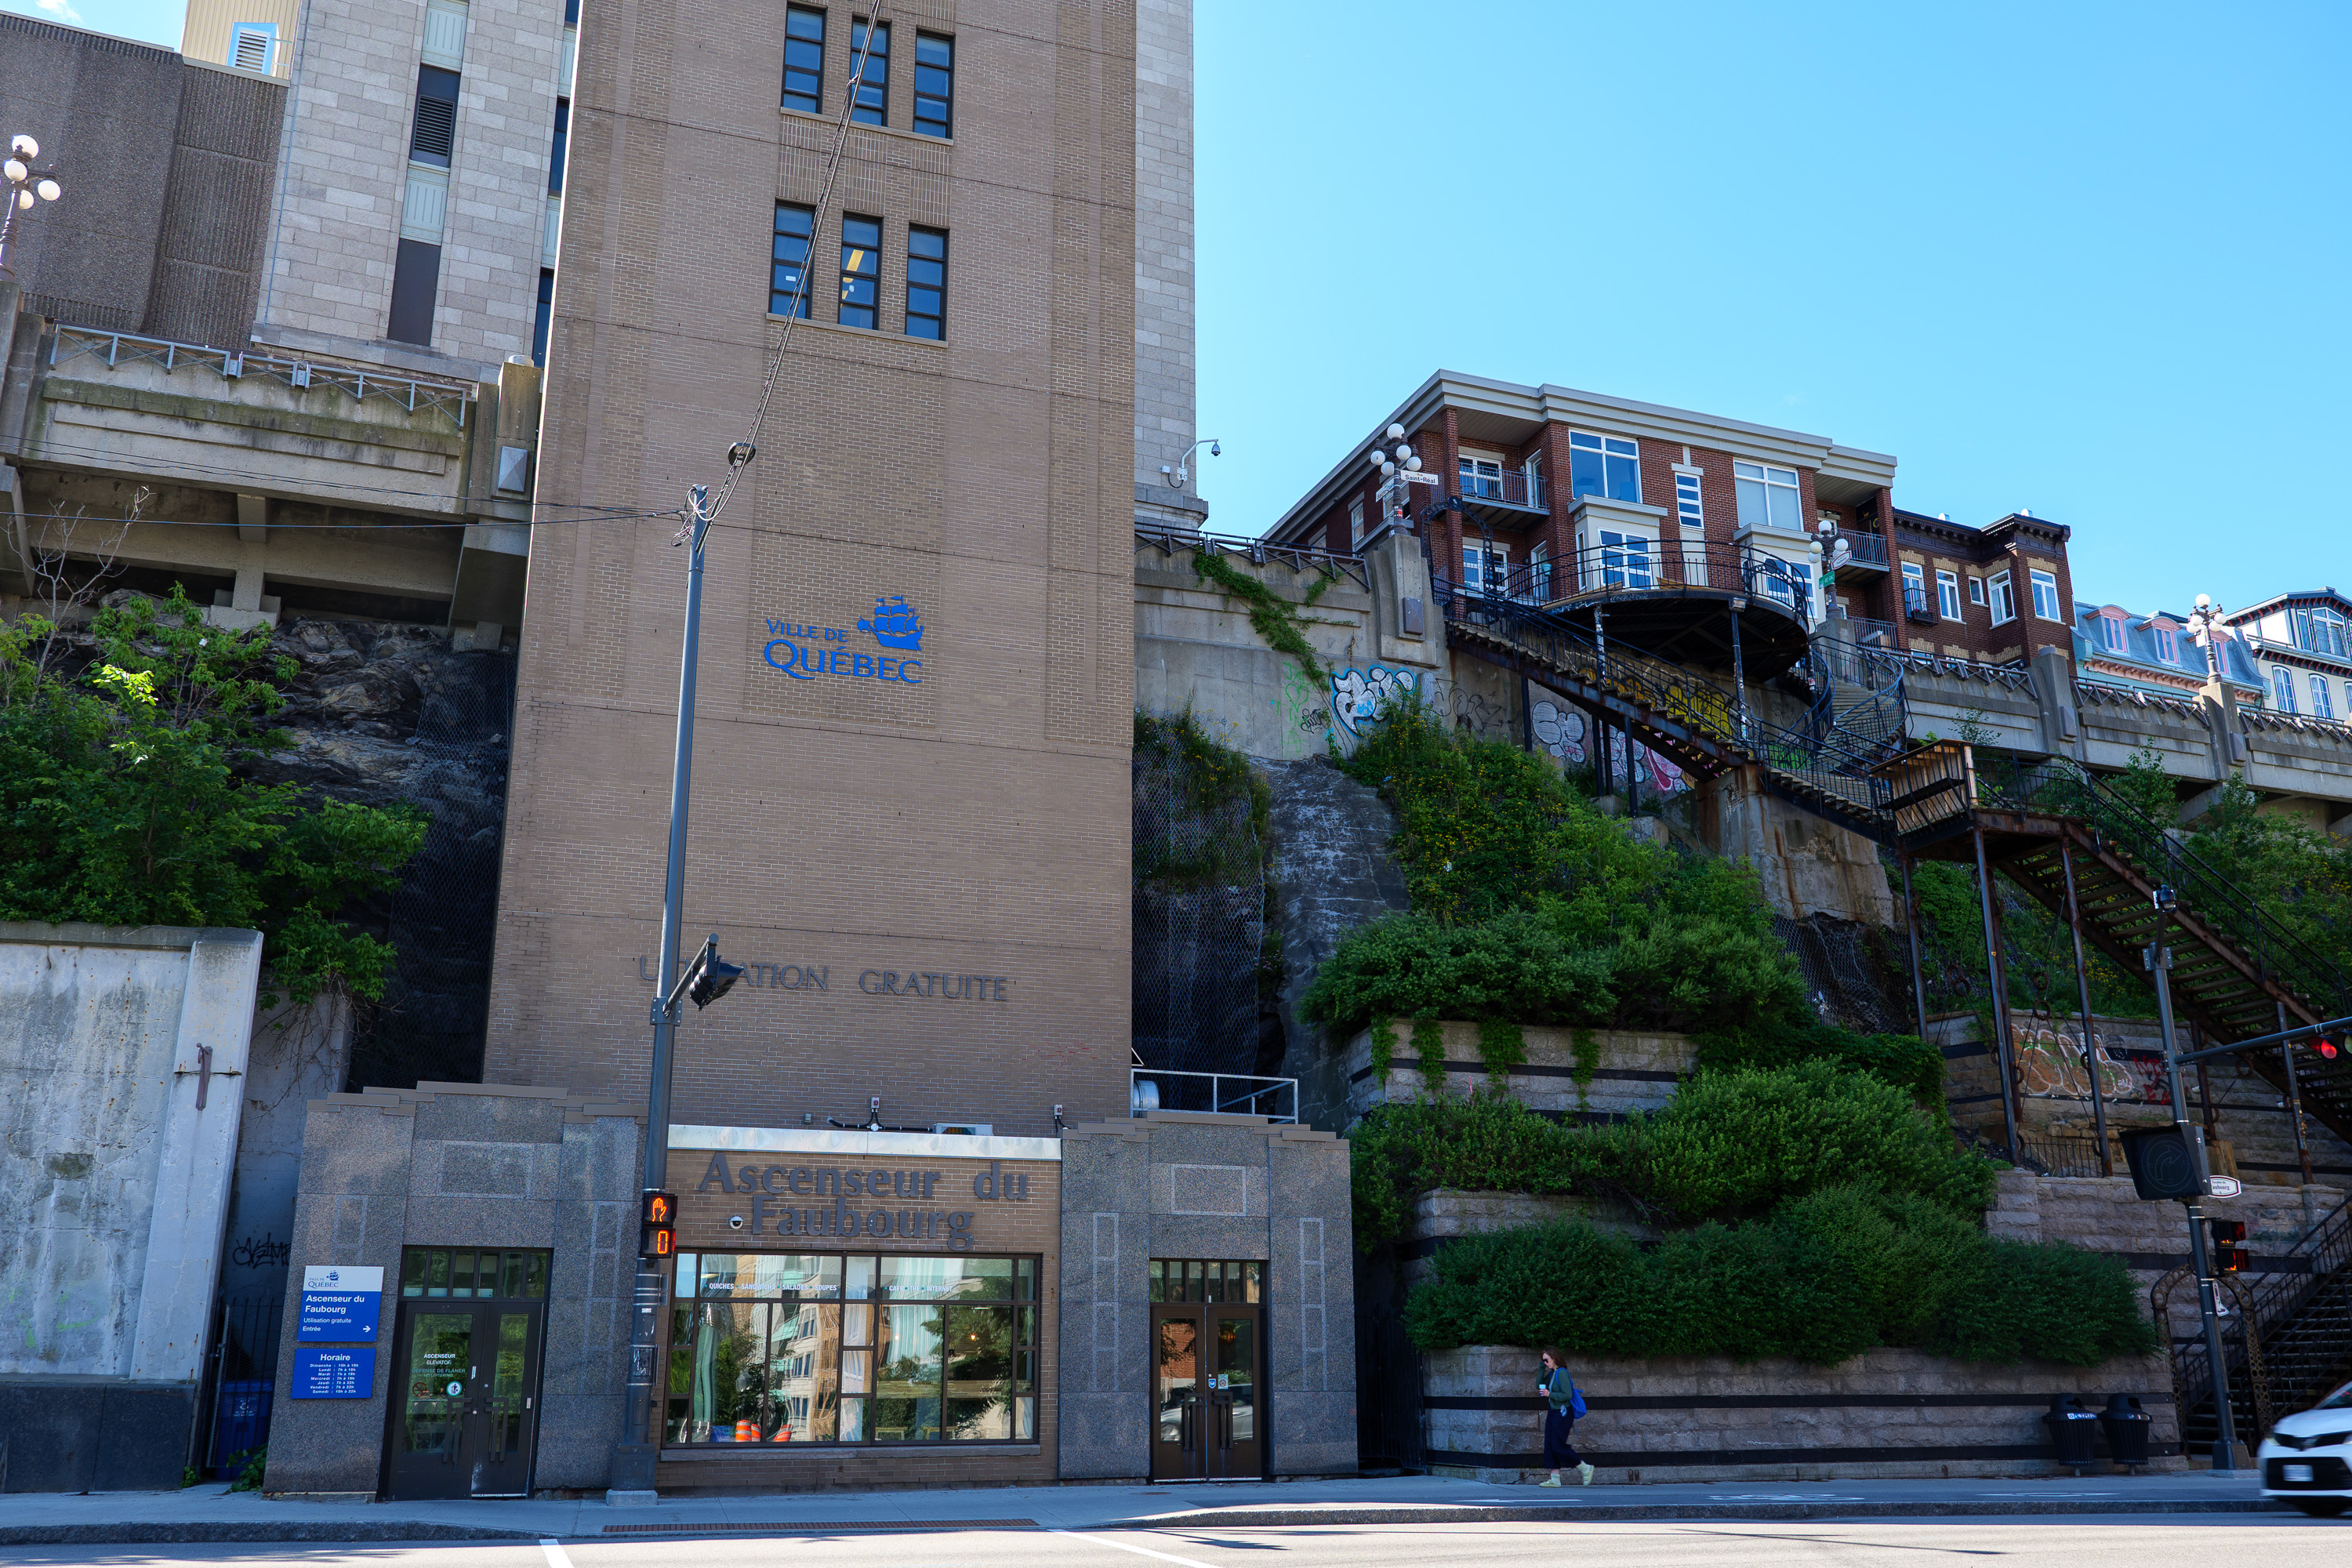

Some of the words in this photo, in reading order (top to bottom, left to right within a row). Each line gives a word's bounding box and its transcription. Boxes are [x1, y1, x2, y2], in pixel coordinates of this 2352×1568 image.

[1405, 474, 1436, 484] Saint-Réal
[766, 619, 818, 639] VILLE
[825, 628, 848, 642] DE
[764, 639, 922, 684] QUÉBEC
[859, 970, 1008, 1000] GRATUITE
[699, 1152, 940, 1198] Ascenseur
[974, 1161, 1028, 1200] du
[752, 1195, 975, 1251] Faubourg
[305, 1305, 347, 1314] Faubourg
